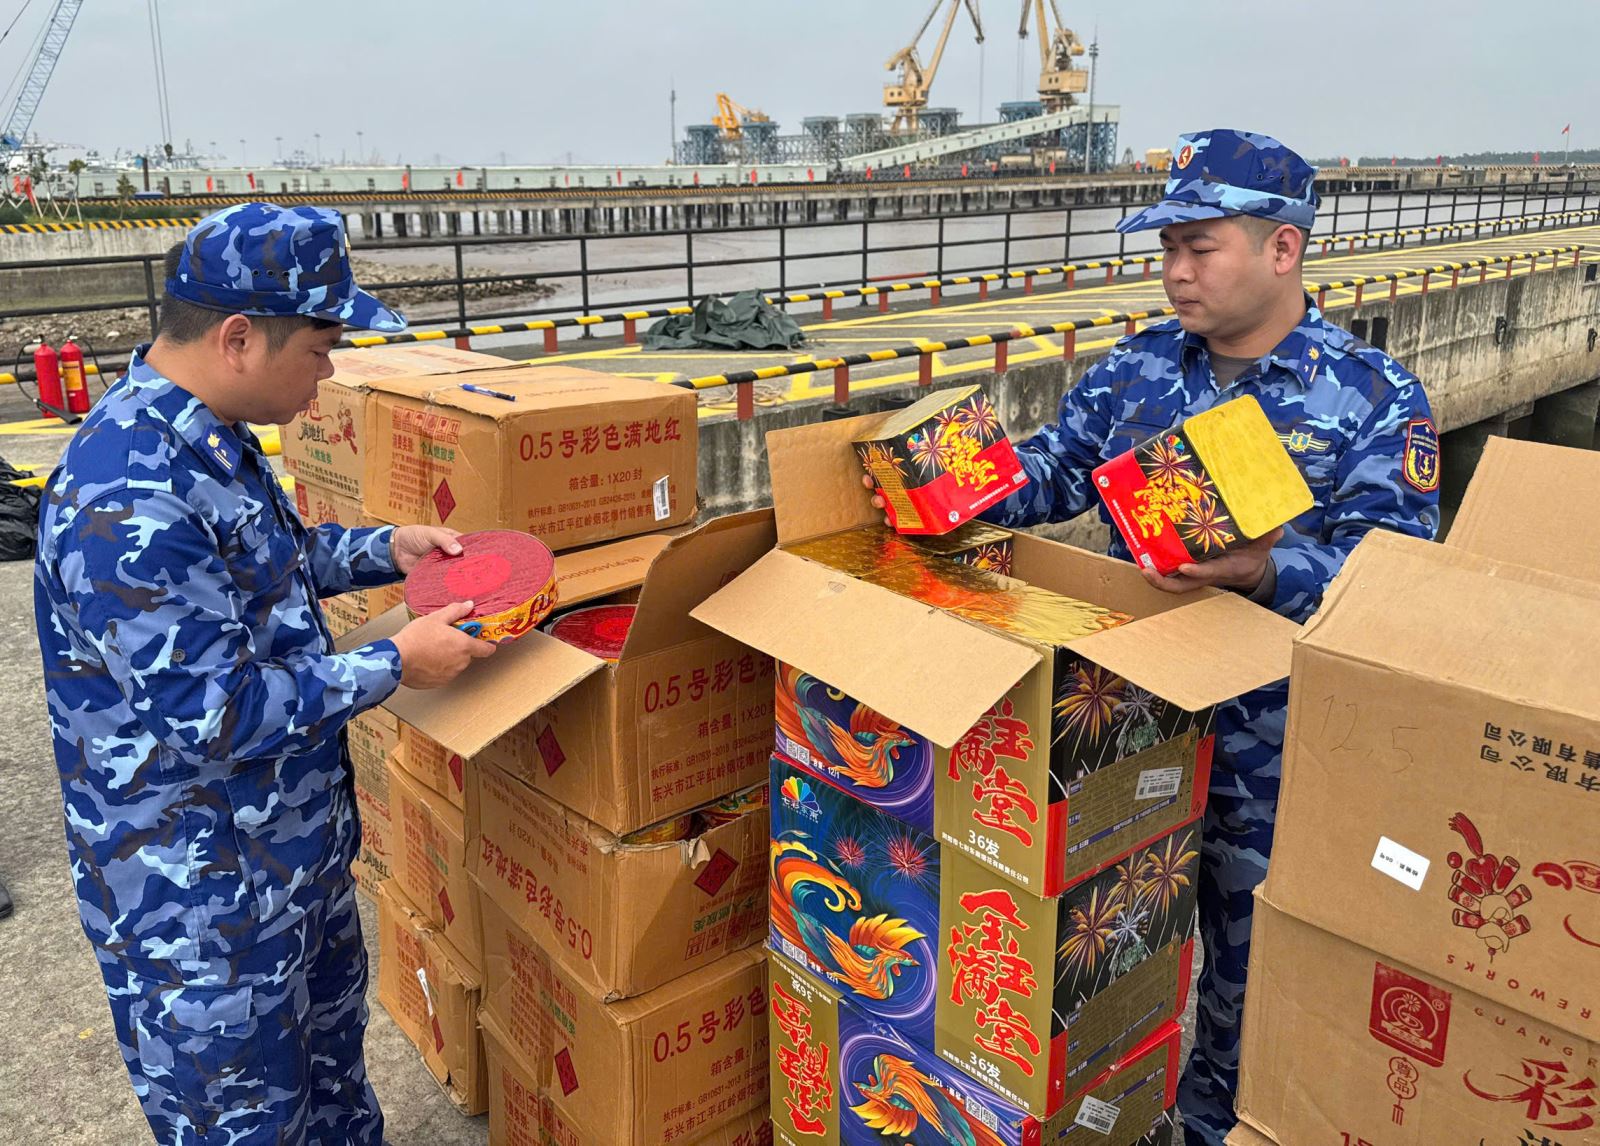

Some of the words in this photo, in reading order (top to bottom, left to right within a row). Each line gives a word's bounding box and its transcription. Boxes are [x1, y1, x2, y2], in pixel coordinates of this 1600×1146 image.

[519, 416, 682, 461] 0.5号彩色满地红
[968, 829, 1000, 859] 36发
[481, 833, 593, 960] 0.5号彩色满地红
[969, 1051, 1001, 1082] 36发
